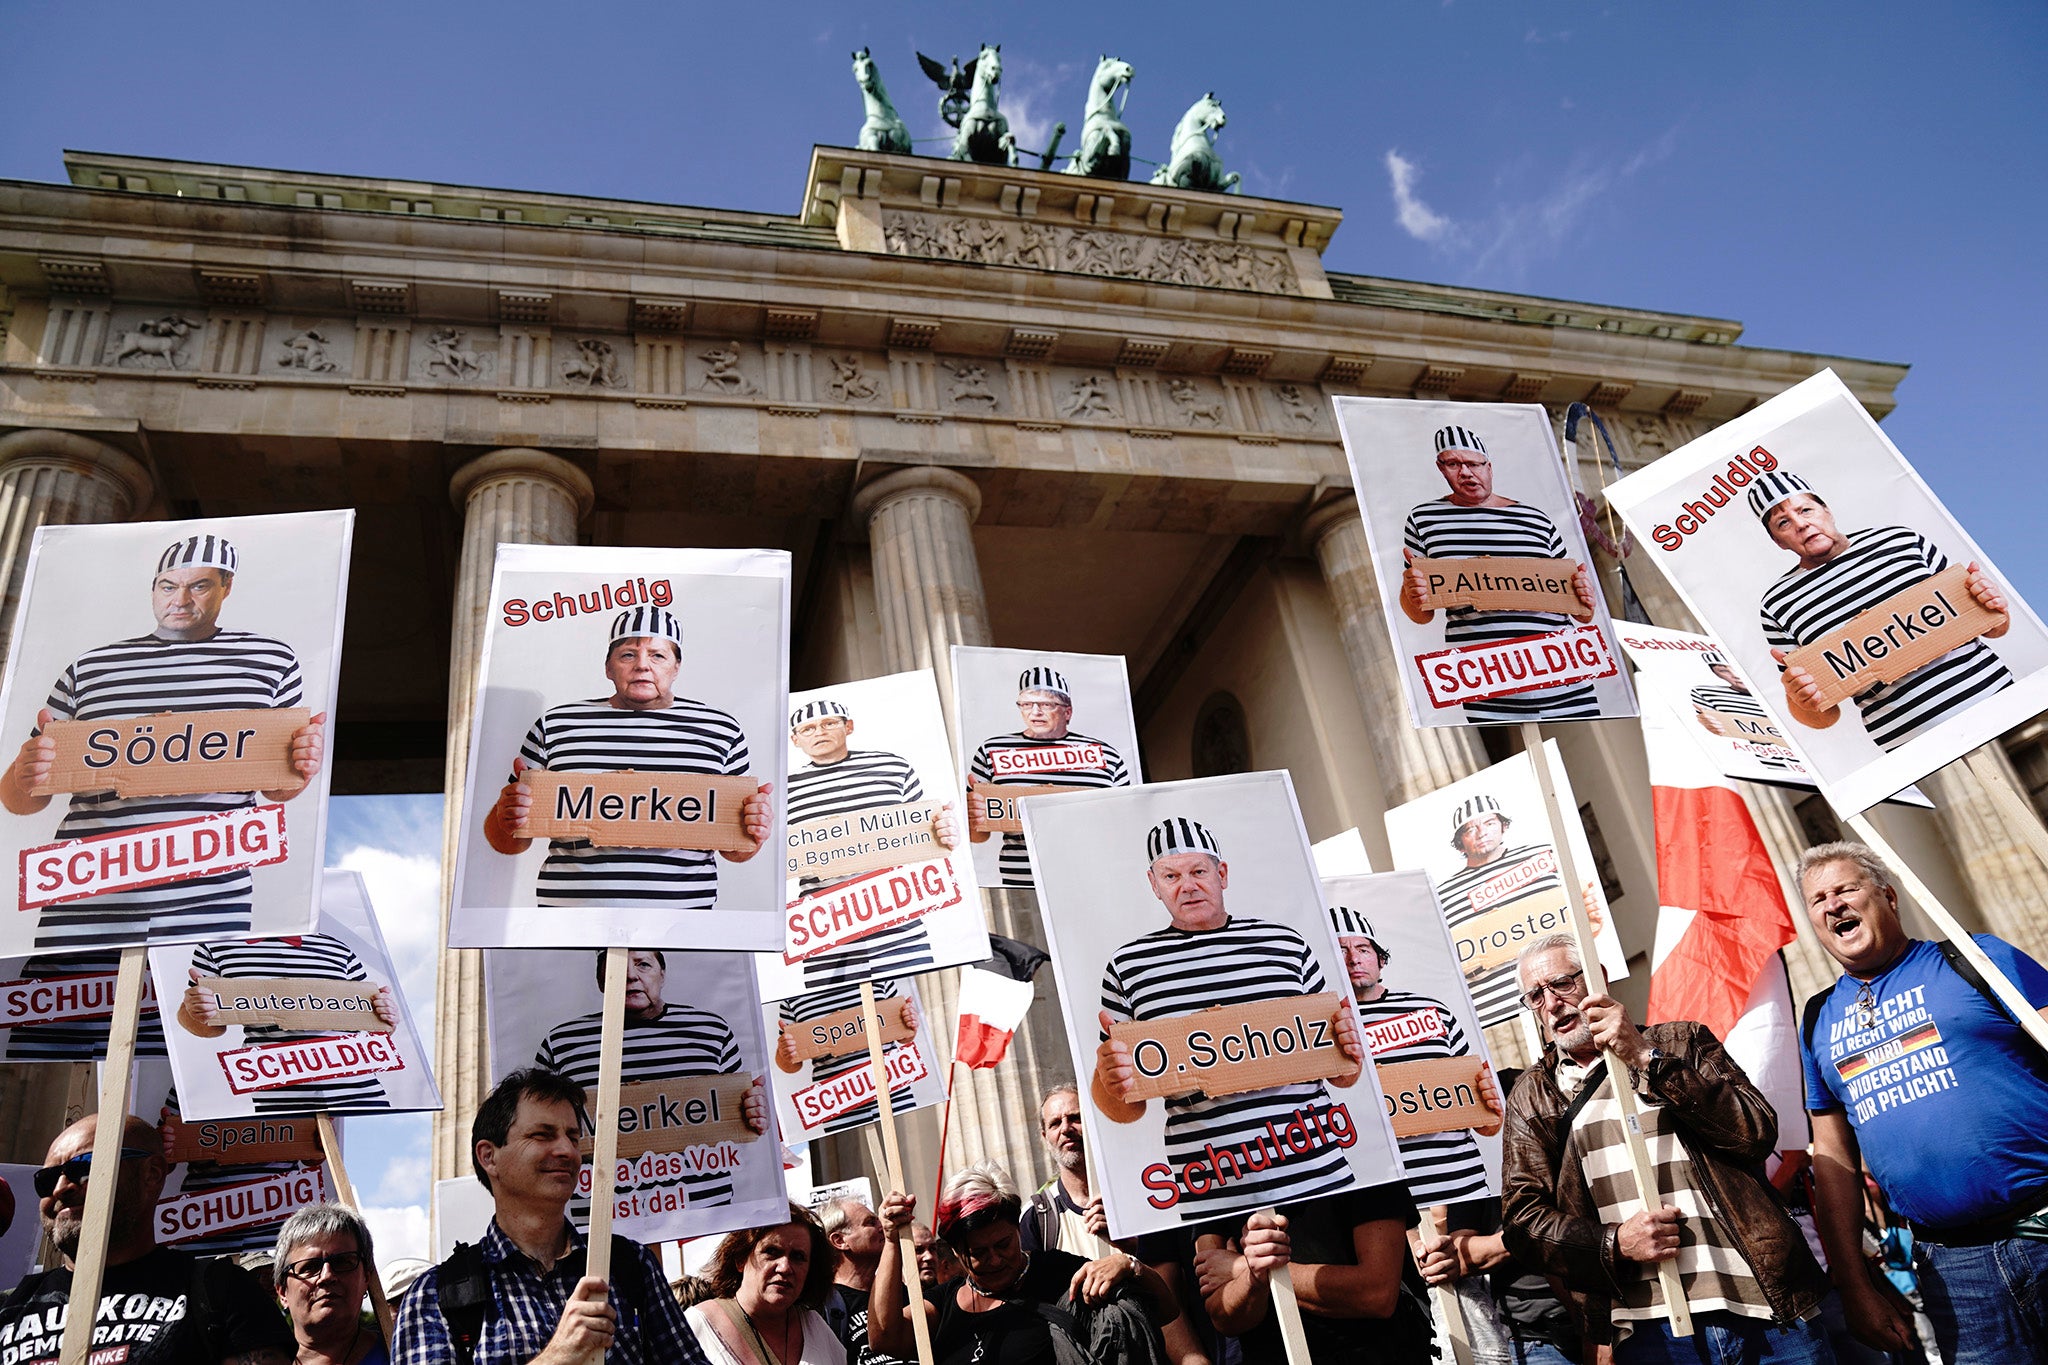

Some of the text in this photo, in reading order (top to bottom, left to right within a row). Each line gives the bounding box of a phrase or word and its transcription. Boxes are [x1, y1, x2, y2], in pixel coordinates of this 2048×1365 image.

[1652, 445, 1778, 553] Schuldig
[503, 577, 674, 628] Schuldig
[1428, 572, 1568, 596] P.Altmaier
[1823, 590, 1958, 681] Merkel
[1434, 638, 1602, 694] SCHULDIG
[84, 723, 256, 770] Söder
[1000, 749, 1098, 770] SCHULDIG
[555, 785, 717, 824] Merkel
[788, 808, 932, 848] chael Müller
[37, 818, 270, 893] SCHULDIG
[788, 831, 931, 872] g.Bgmstr.Berlin
[1475, 857, 1549, 905] SCHULDIG
[788, 864, 946, 947] SCHULDIG
[214, 992, 374, 1012] Lauterbach
[1132, 1015, 1334, 1079] O.Scholz
[1366, 1013, 1438, 1049] CHULDIG
[1829, 1006, 1933, 1061] ZU RECHT WIRD,
[1864, 1039, 1905, 1067] WIRD
[234, 1040, 390, 1083] SCHULDIG
[1846, 1046, 1950, 1102] WIDERSTAND
[1384, 1082, 1475, 1118] osten
[1854, 1067, 1959, 1125] ZUR PFLICHT!
[199, 1121, 295, 1152] Spahn
[690, 1145, 741, 1171] Volk
[1140, 1102, 1358, 1210] Schuldig
[160, 1178, 315, 1236] SCHULDIG
[649, 1187, 686, 1214] da!
